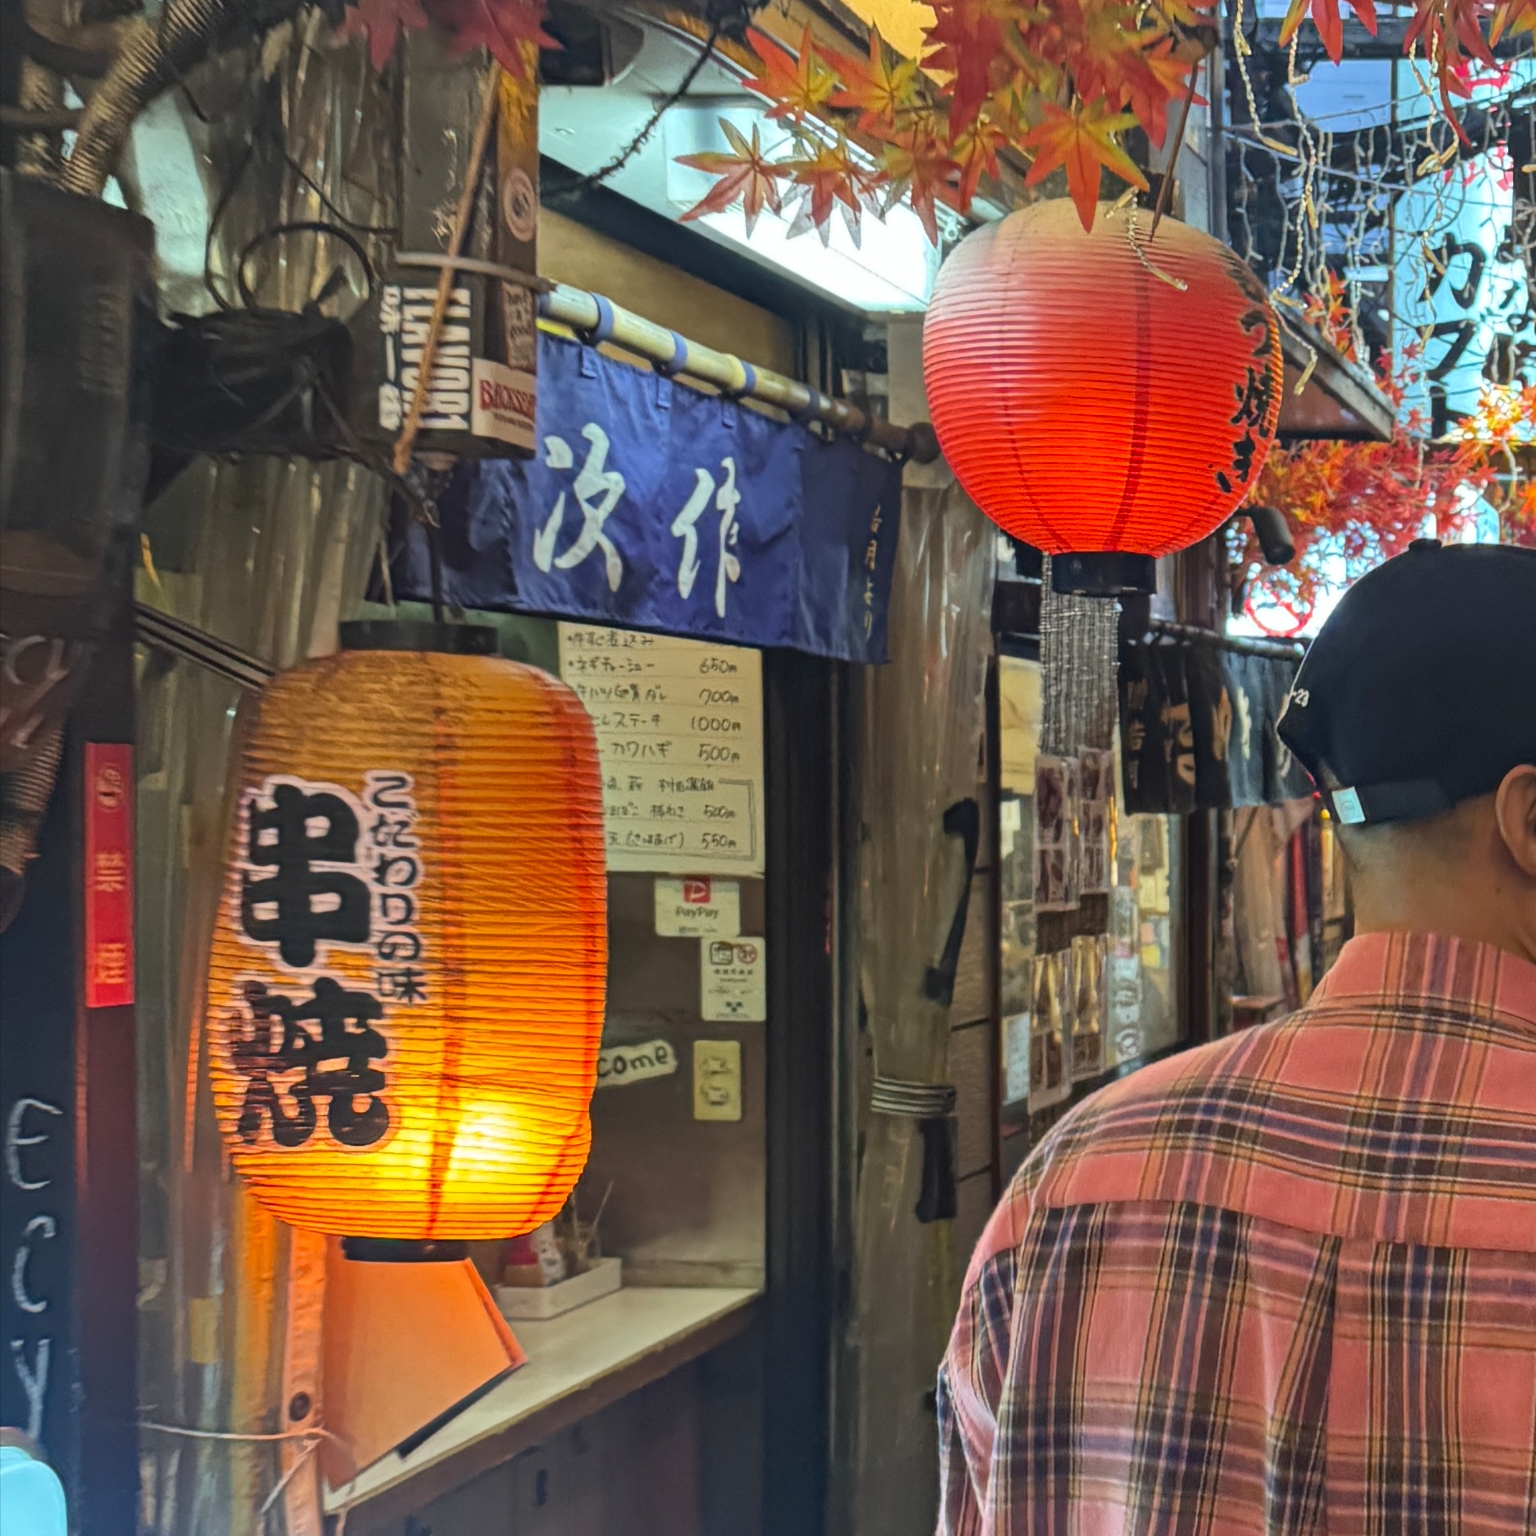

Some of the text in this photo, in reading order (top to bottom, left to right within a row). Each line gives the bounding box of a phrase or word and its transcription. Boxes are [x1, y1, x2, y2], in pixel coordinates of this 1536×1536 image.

[366, 773, 428, 1005] こだわりの味
[674, 906, 719, 921] PayPay
